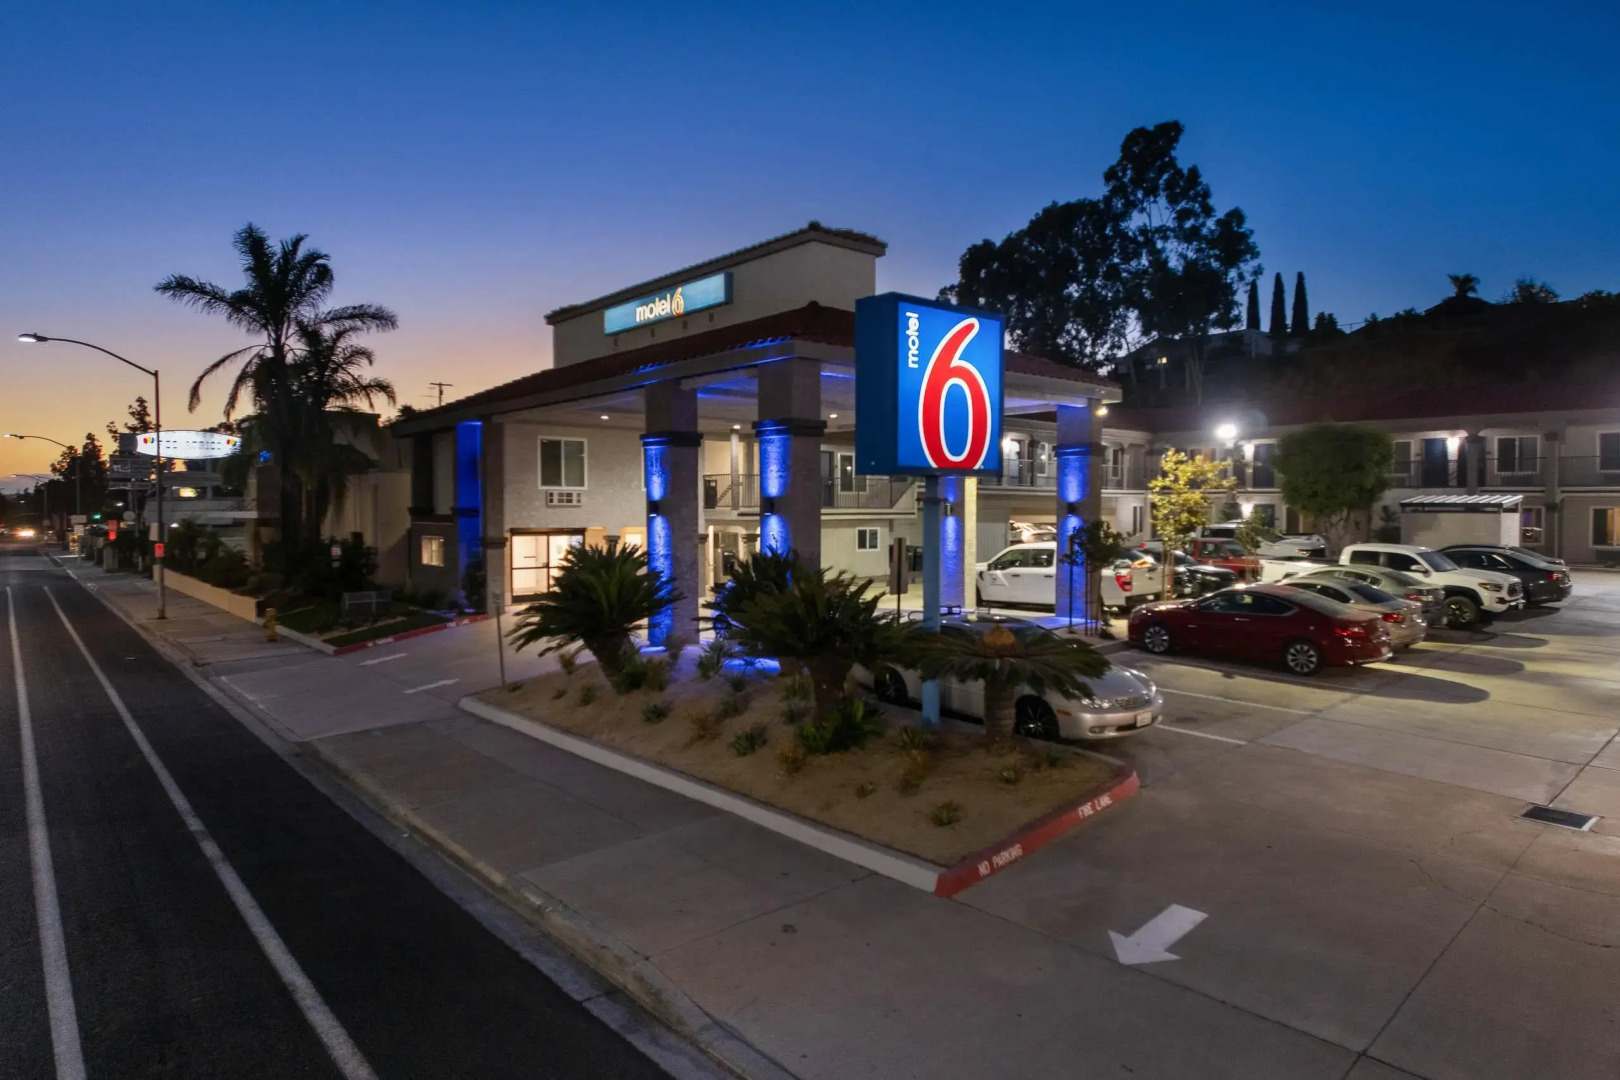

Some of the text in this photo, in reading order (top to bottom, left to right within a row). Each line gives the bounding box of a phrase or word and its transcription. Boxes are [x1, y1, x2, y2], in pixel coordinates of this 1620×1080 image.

[635, 287, 684, 323] motel 6
[905, 312, 992, 470] motel 6
[977, 843, 1022, 876] NO PARKING
